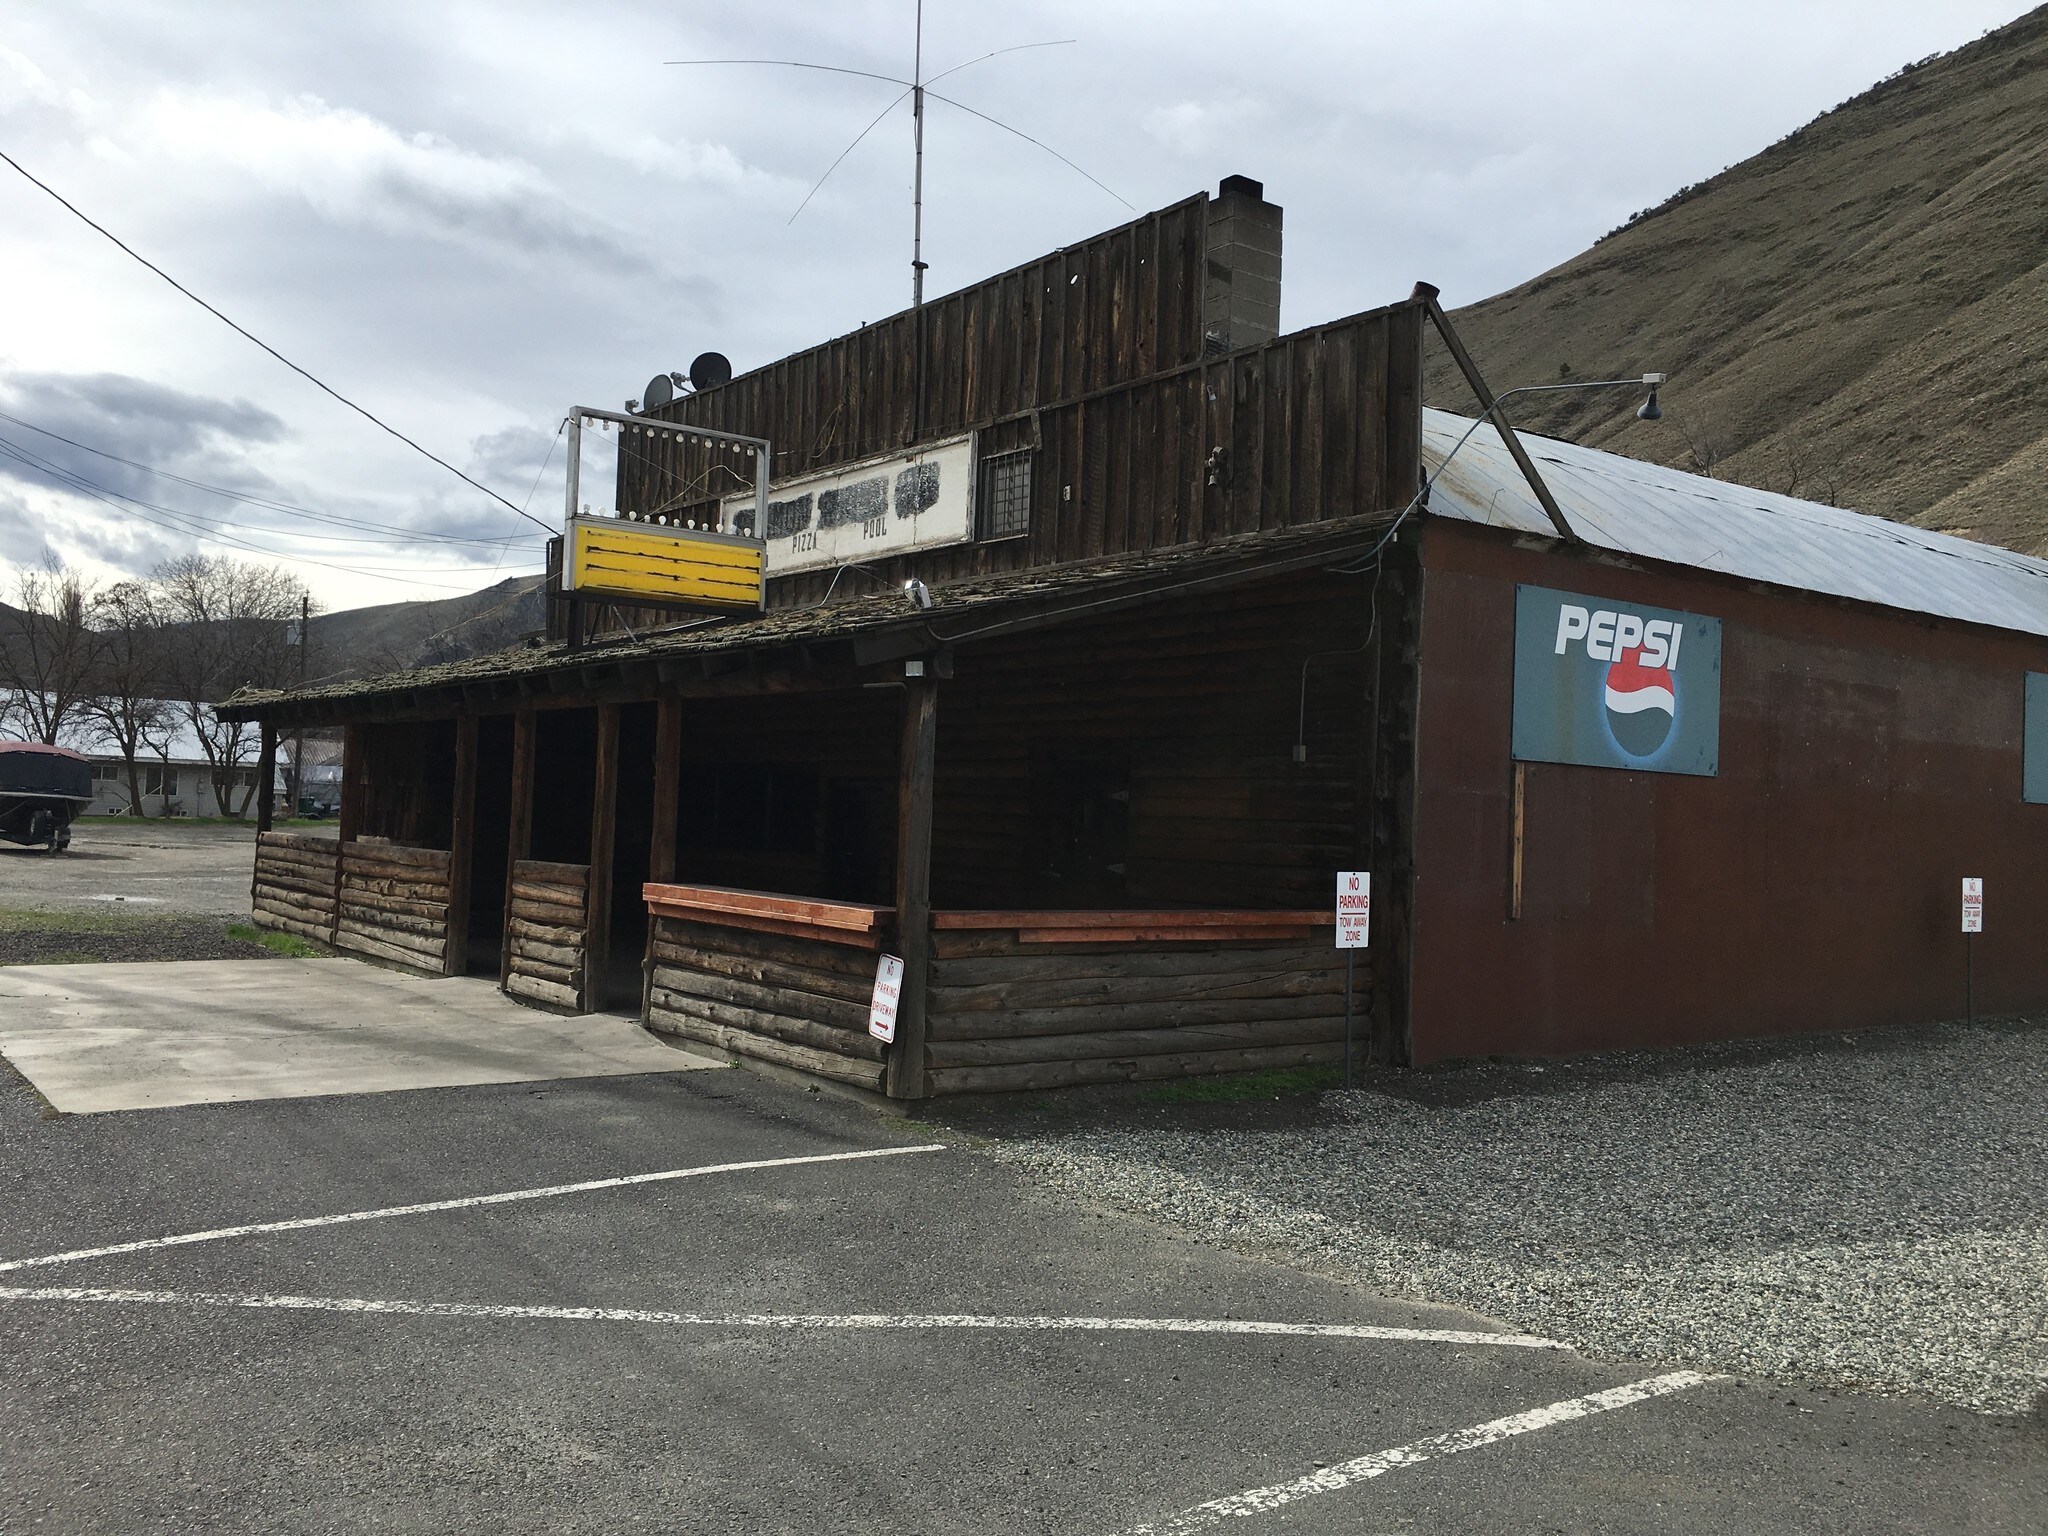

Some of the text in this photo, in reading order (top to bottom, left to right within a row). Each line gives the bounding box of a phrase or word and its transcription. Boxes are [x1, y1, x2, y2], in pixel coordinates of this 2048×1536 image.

[792, 517, 887, 554] PIZZA POOL
[1554, 604, 1683, 671] PEPSI
[1348, 877, 1359, 890] NO
[1339, 895, 1368, 908] PARKING
[1964, 894, 1981, 904] PARKING
[1339, 917, 1367, 927] TOW AWAY
[1345, 931, 1360, 941] ZONE
[886, 964, 895, 976] NO
[877, 982, 897, 998] PARKING
[872, 1000, 896, 1019] DRIVEWAY
